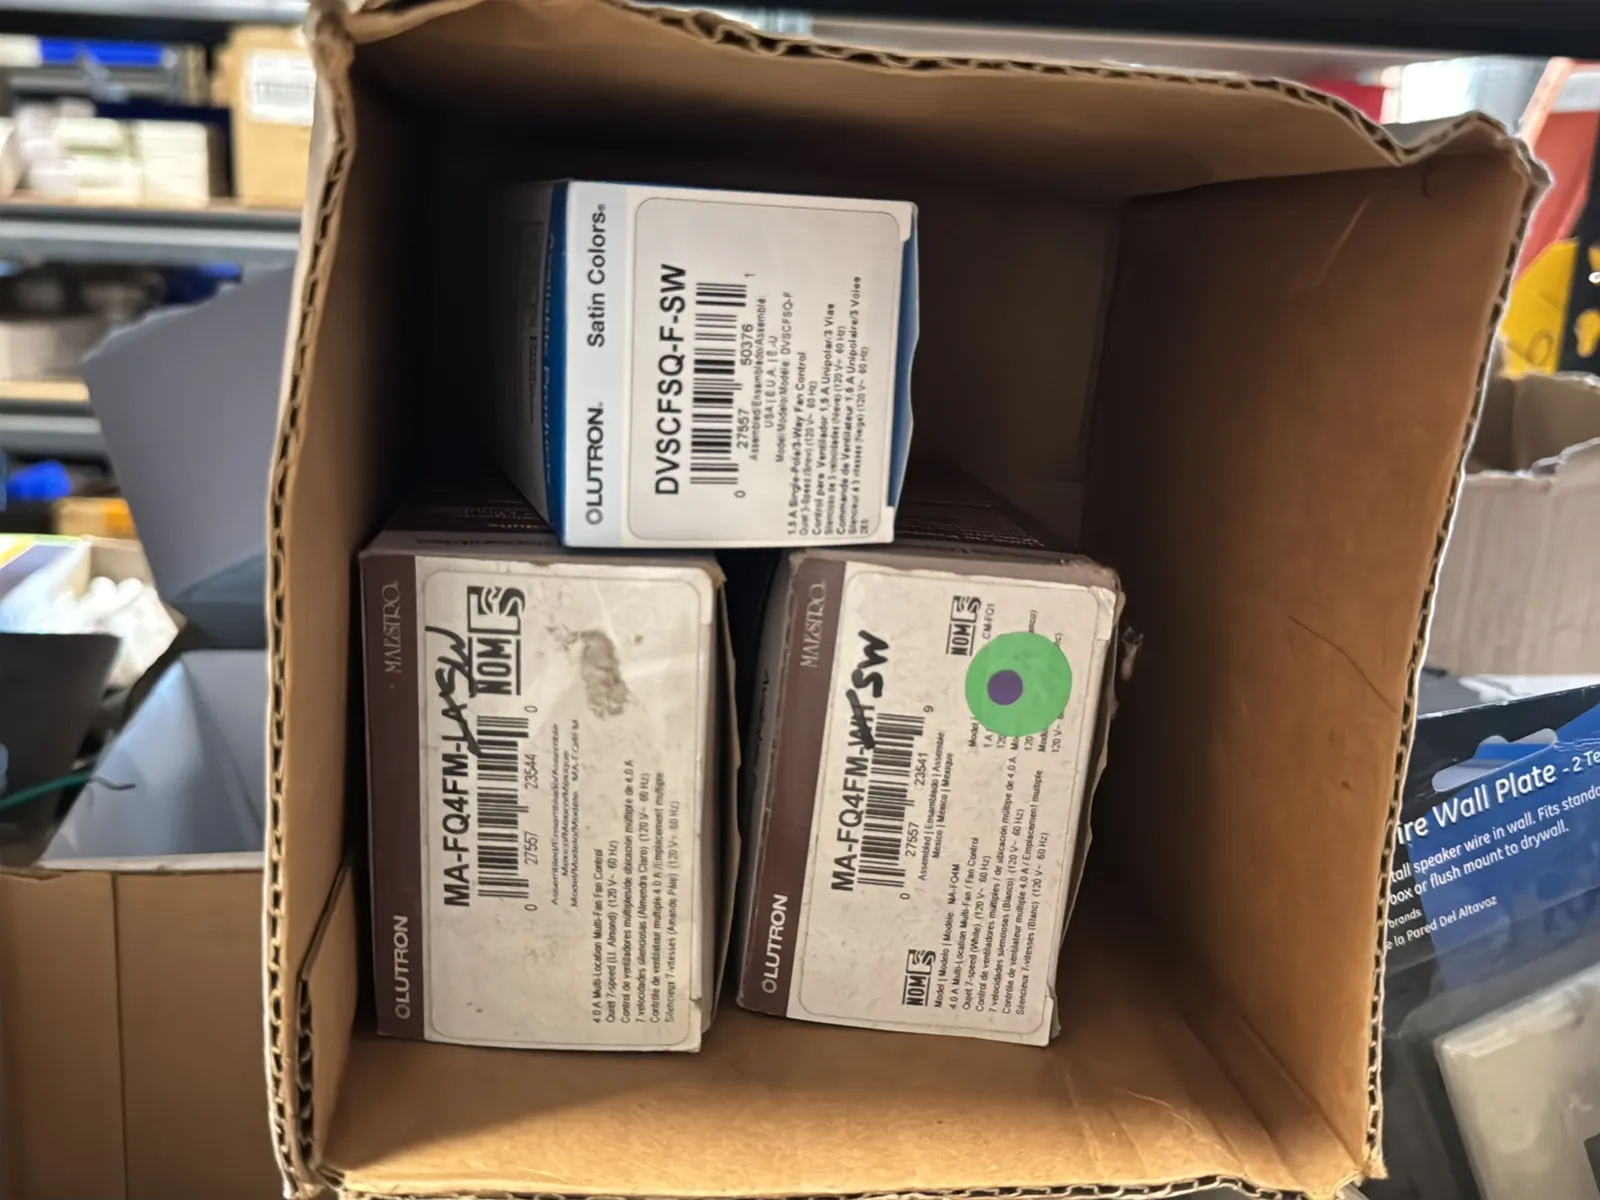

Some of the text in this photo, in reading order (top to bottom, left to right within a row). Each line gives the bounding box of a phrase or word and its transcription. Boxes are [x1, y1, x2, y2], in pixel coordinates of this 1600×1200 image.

[588, 292, 605, 346] Satin
[740, 323, 753, 365] 50376
[655, 263, 685, 494] DVSCFSQ-F-SW
[796, 351, 806, 390] Control
[794, 393, 804, 411] Fan
[737, 407, 749, 447] 27557
[816, 415, 827, 467] Ventilador
[841, 405, 853, 459] Ventilateur
[815, 472, 825, 495] para
[840, 462, 850, 474] de
[813, 498, 822, 534] Control
[837, 478, 849, 534] Commande
[851, 629, 890, 697] SW
[968, 722, 978, 746] Model
[1024, 735, 1033, 749] 120
[1052, 738, 1061, 751] 120
[625, 784, 633, 795] de
[904, 821, 920, 856] 27557
[913, 751, 929, 785] 23541
[922, 704, 934, 712] 9
[1005, 779, 1013, 790] de
[525, 704, 538, 911] 0 27557 23544 0
[1396, 815, 1429, 846] ire
[1432, 783, 1490, 830] Wall
[1495, 763, 1557, 805] Plate
[1572, 756, 1582, 772] 2
[639, 821, 650, 840] (120
[918, 836, 931, 880] Assembled
[926, 778, 939, 828] Ensamblado
[932, 829, 943, 857] Mexico
[1023, 803, 1037, 859] Emplacement
[1413, 842, 1462, 875] speaker
[1464, 831, 1491, 851] wire
[1493, 825, 1505, 840] in
[1506, 812, 1536, 836] wall.
[1537, 804, 1560, 824] Fits
[638, 846, 649, 872] Claro)
[668, 849, 679, 867] (120
[980, 854, 991, 869] Hz)
[993, 865, 1003, 875] de
[1415, 881, 1428, 897] or
[1430, 867, 1461, 892] flush
[1463, 850, 1504, 878] mount
[1505, 840, 1519, 857] to
[1520, 821, 1570, 852] drywall.
[978, 871, 988, 881] 60
[592, 848, 603, 997] Multi-Location Multi-Fan Fan Control
[952, 836, 978, 984] Multi-Location Multi-Fan Fan Control
[973, 901, 984, 918] (120
[991, 808, 1024, 1005] velocidades silenciosas (Blanco) (120 60 Hz)
[1015, 891, 1027, 921] multiple
[1015, 831, 1049, 1014] Silencieux 7-vitesses (Blanc) (120 60 Hz)
[1394, 895, 1498, 948] la Pared Del Altavoz
[606, 839, 619, 1022] Quiet 7-speed Almond) (120 60 Hz)
[637, 921, 647, 964] silenciosas
[981, 920, 995, 967] ventiladores
[1009, 924, 1021, 964] ventilateur
[622, 929, 632, 977] ventiladores
[938, 947, 950, 975] Modelo
[965, 953, 978, 985] 7-speed
[621, 981, 631, 990] de
[652, 975, 660, 985] de
[979, 970, 988, 979] de
[1007, 967, 1016, 977] de
[621, 993, 630, 1022] Control
[636, 967, 646, 1015] velocidades
[935, 983, 944, 1007] Model
[962, 987, 973, 1009] Quiet
[975, 982, 987, 1011] Control
[1002, 979, 1014, 1013] Contrôle
